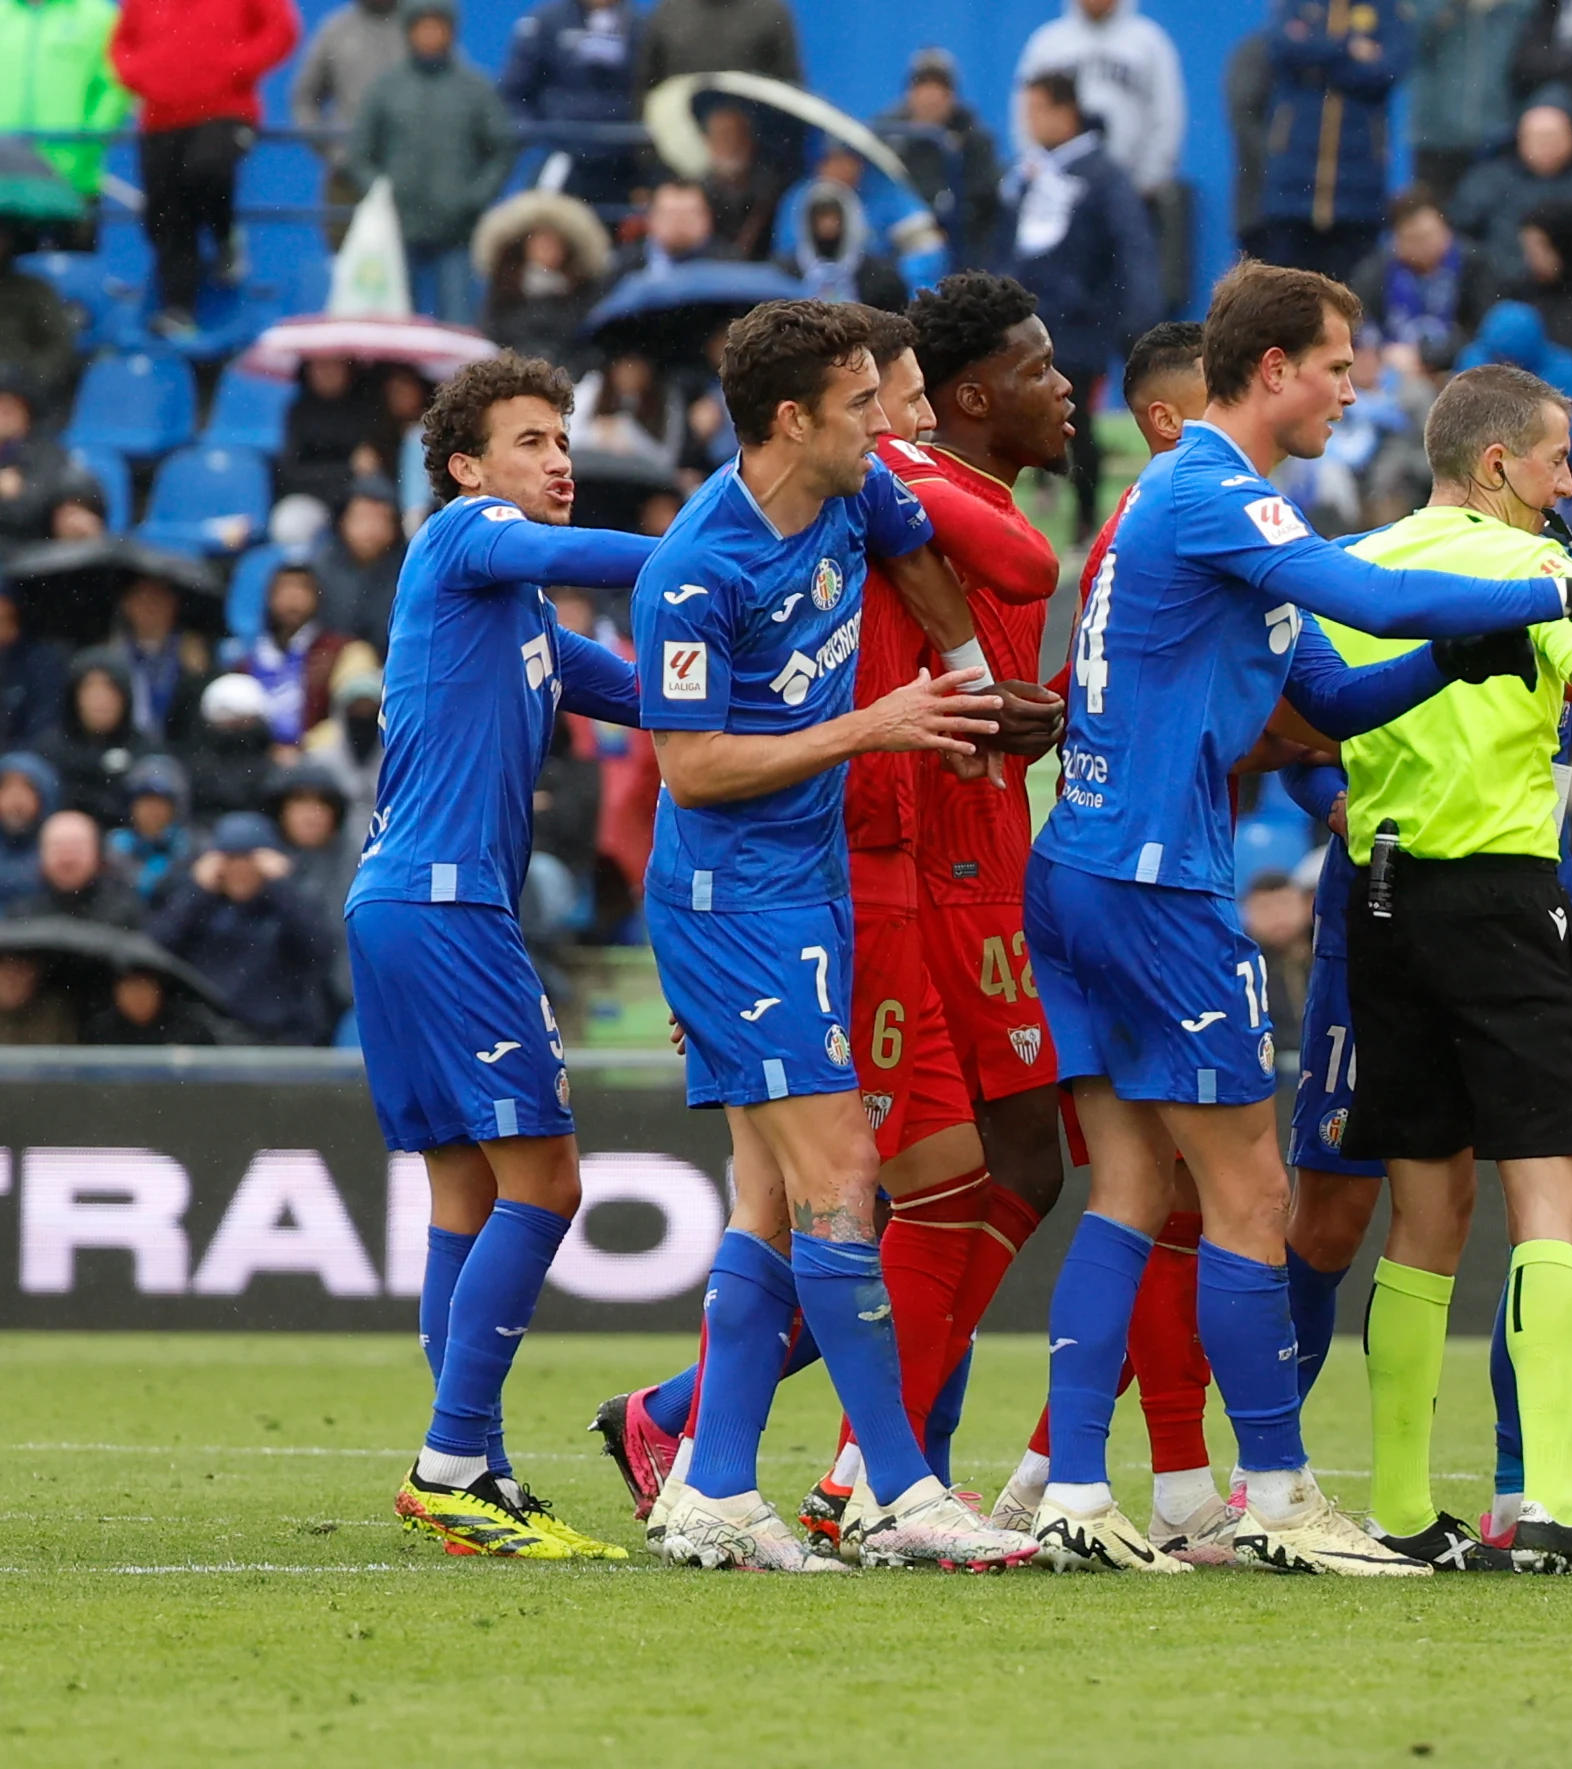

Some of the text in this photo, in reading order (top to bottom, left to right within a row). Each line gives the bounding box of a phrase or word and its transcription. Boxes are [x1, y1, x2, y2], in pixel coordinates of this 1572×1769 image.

[668, 682, 701, 691] LALIGA
[801, 945, 831, 1013] 7
[541, 994, 564, 1060] 5
[871, 999, 906, 1069] 6
